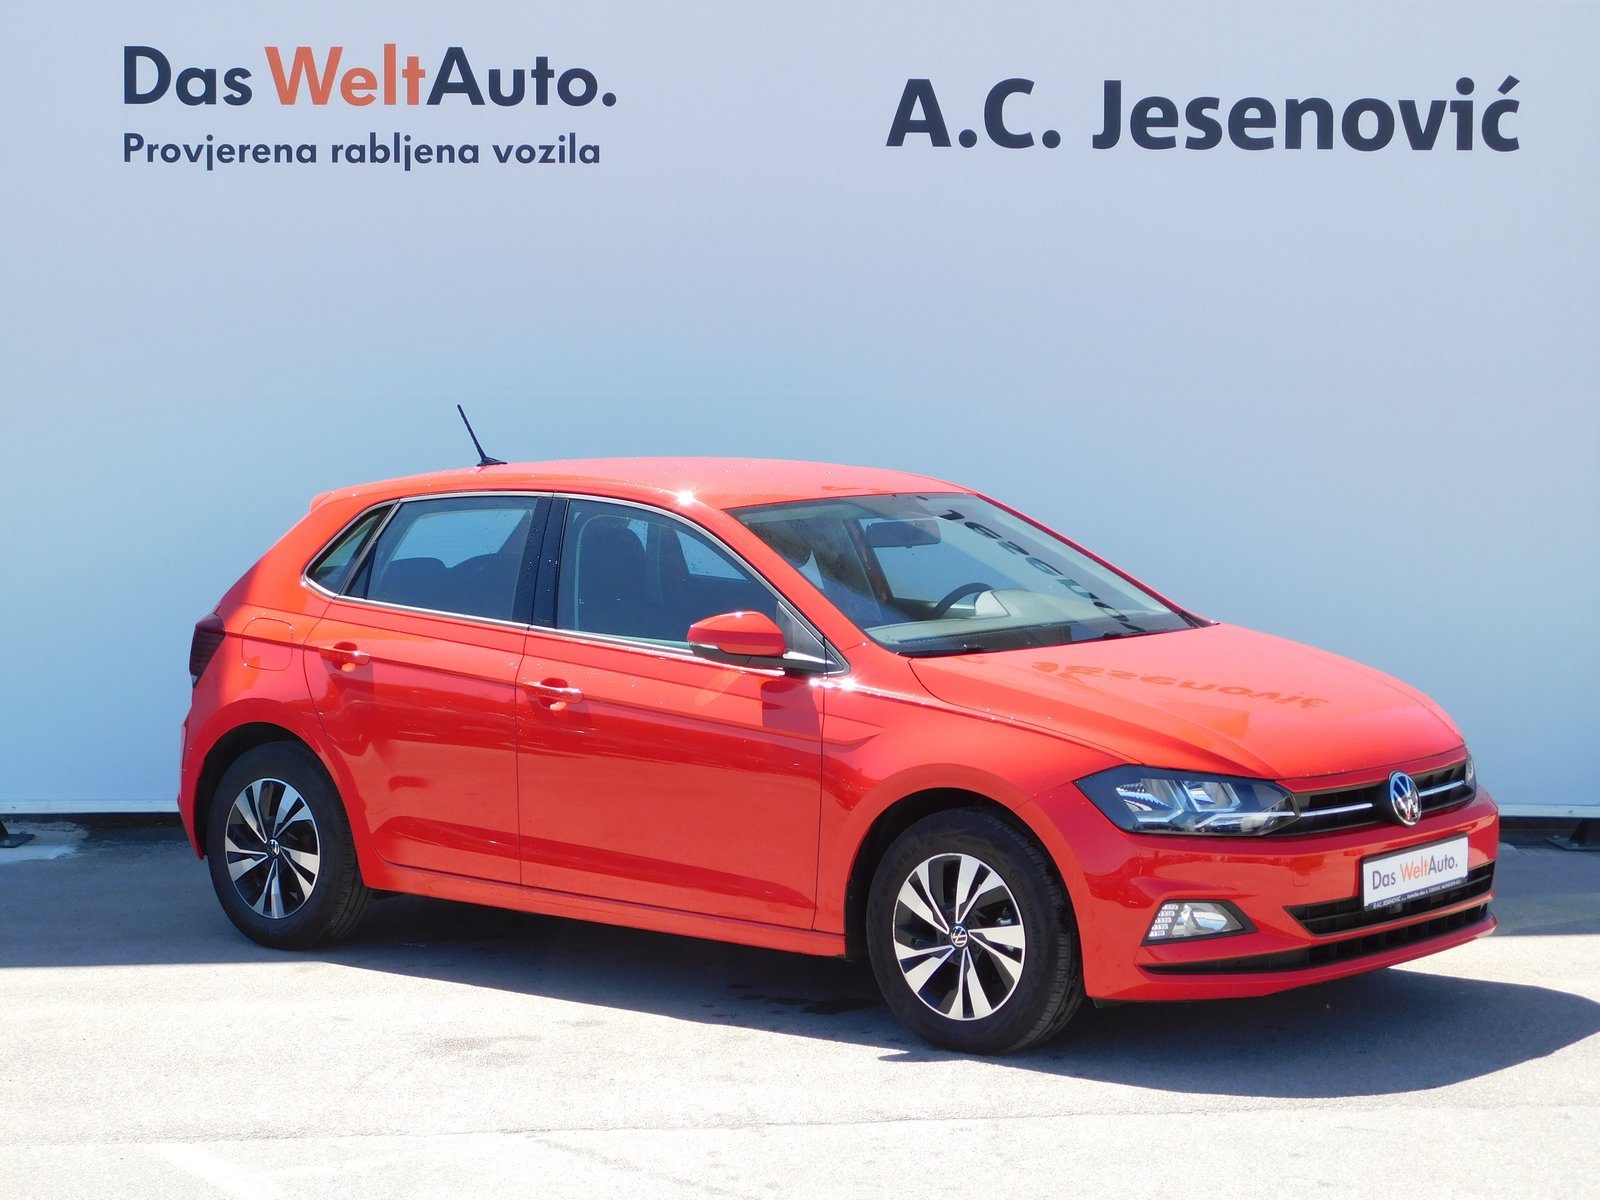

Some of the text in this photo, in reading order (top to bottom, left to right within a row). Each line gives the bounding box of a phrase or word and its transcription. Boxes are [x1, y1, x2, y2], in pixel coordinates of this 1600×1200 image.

[123, 43, 617, 108] Das WeltAuto.
[885, 74, 1521, 153] A.C. Jesenović
[123, 131, 600, 171] Provjerena rabljena vozila
[1372, 854, 1458, 890] Das WeltAuto.
